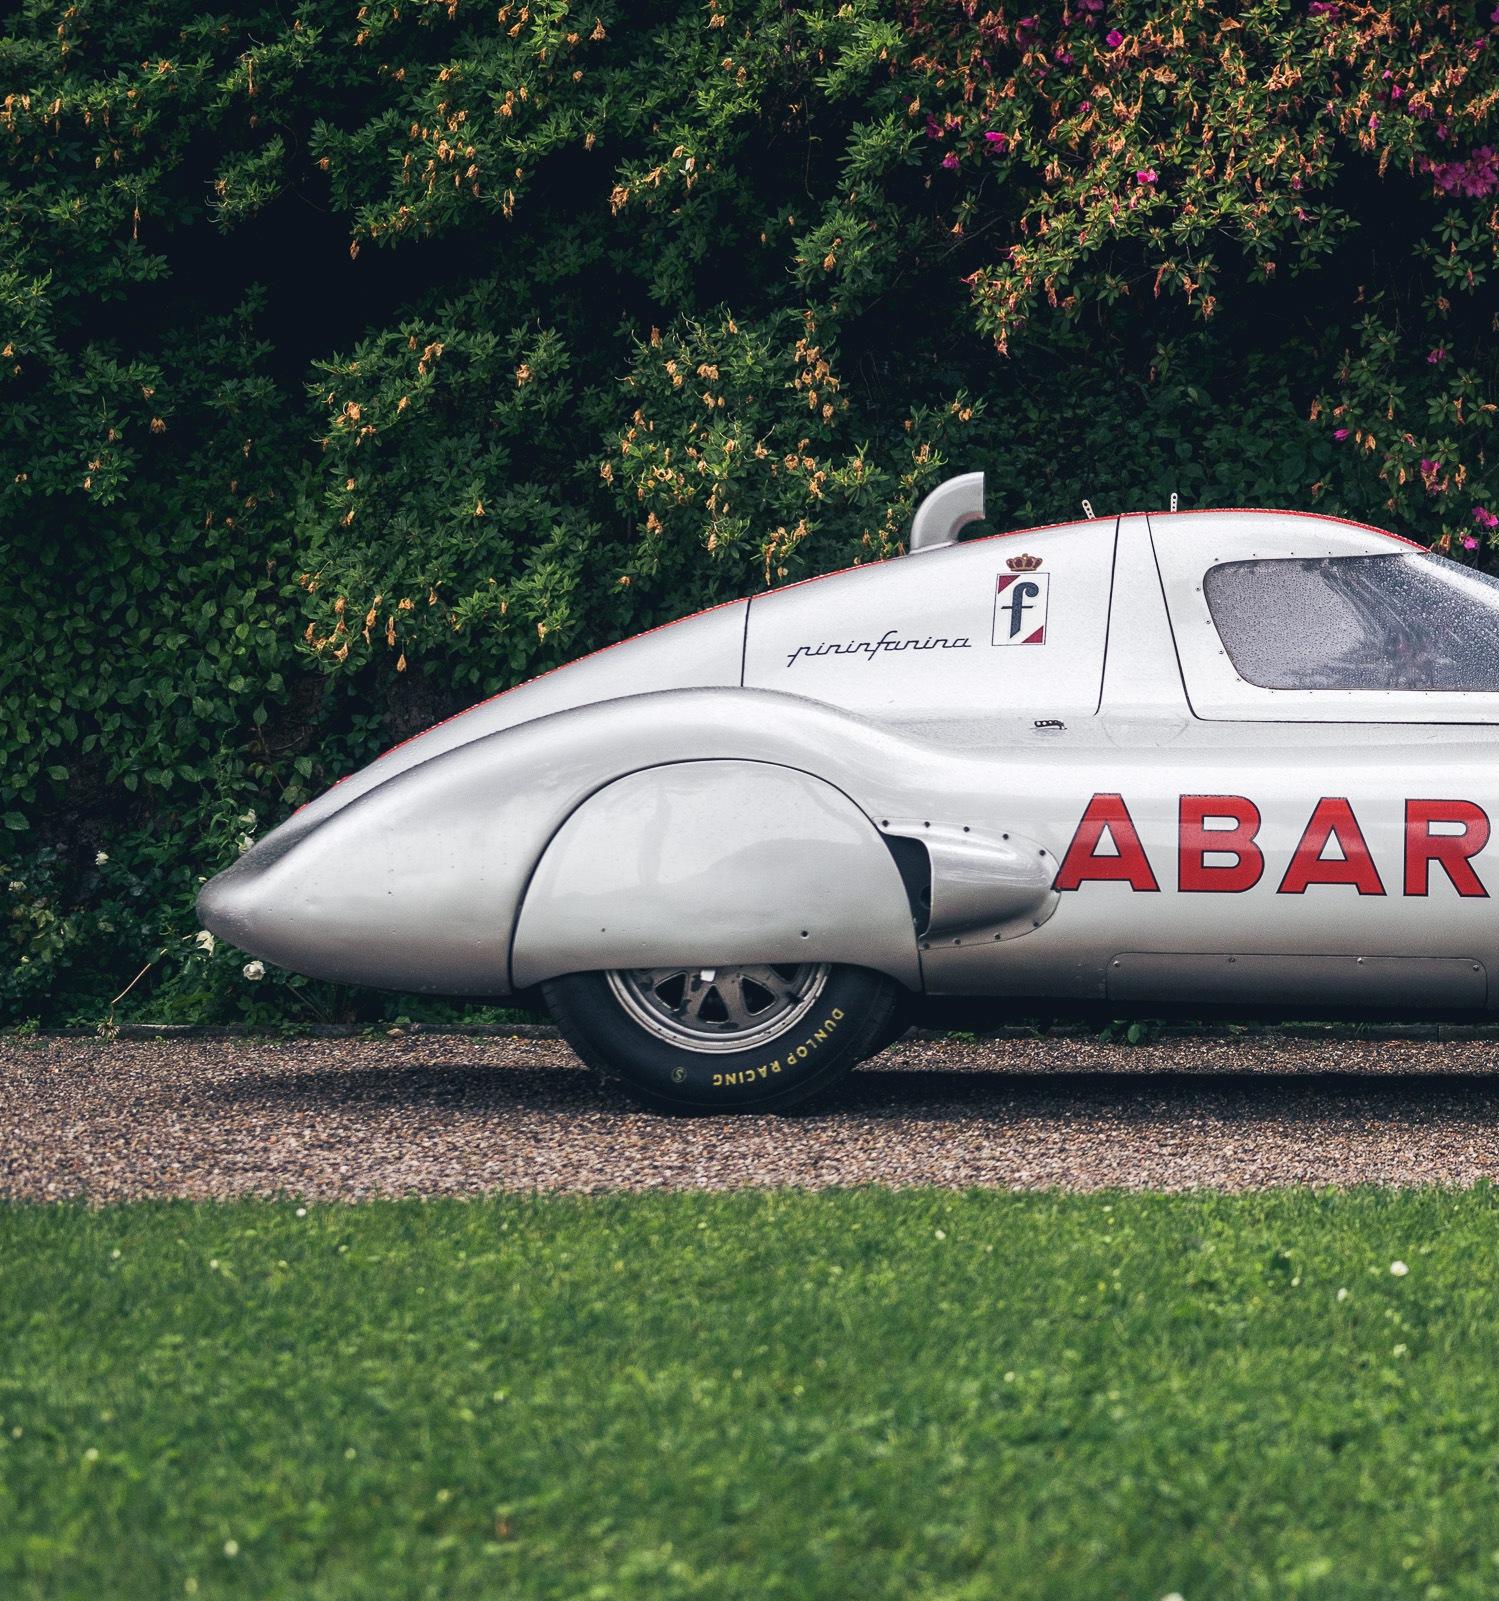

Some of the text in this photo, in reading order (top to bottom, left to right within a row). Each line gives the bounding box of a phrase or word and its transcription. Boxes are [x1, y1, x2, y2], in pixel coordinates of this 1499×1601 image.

[1001, 581, 1040, 639] f
[787, 630, 972, 667] pininfarina
[712, 1007, 845, 1086] DUNLOP RACING
